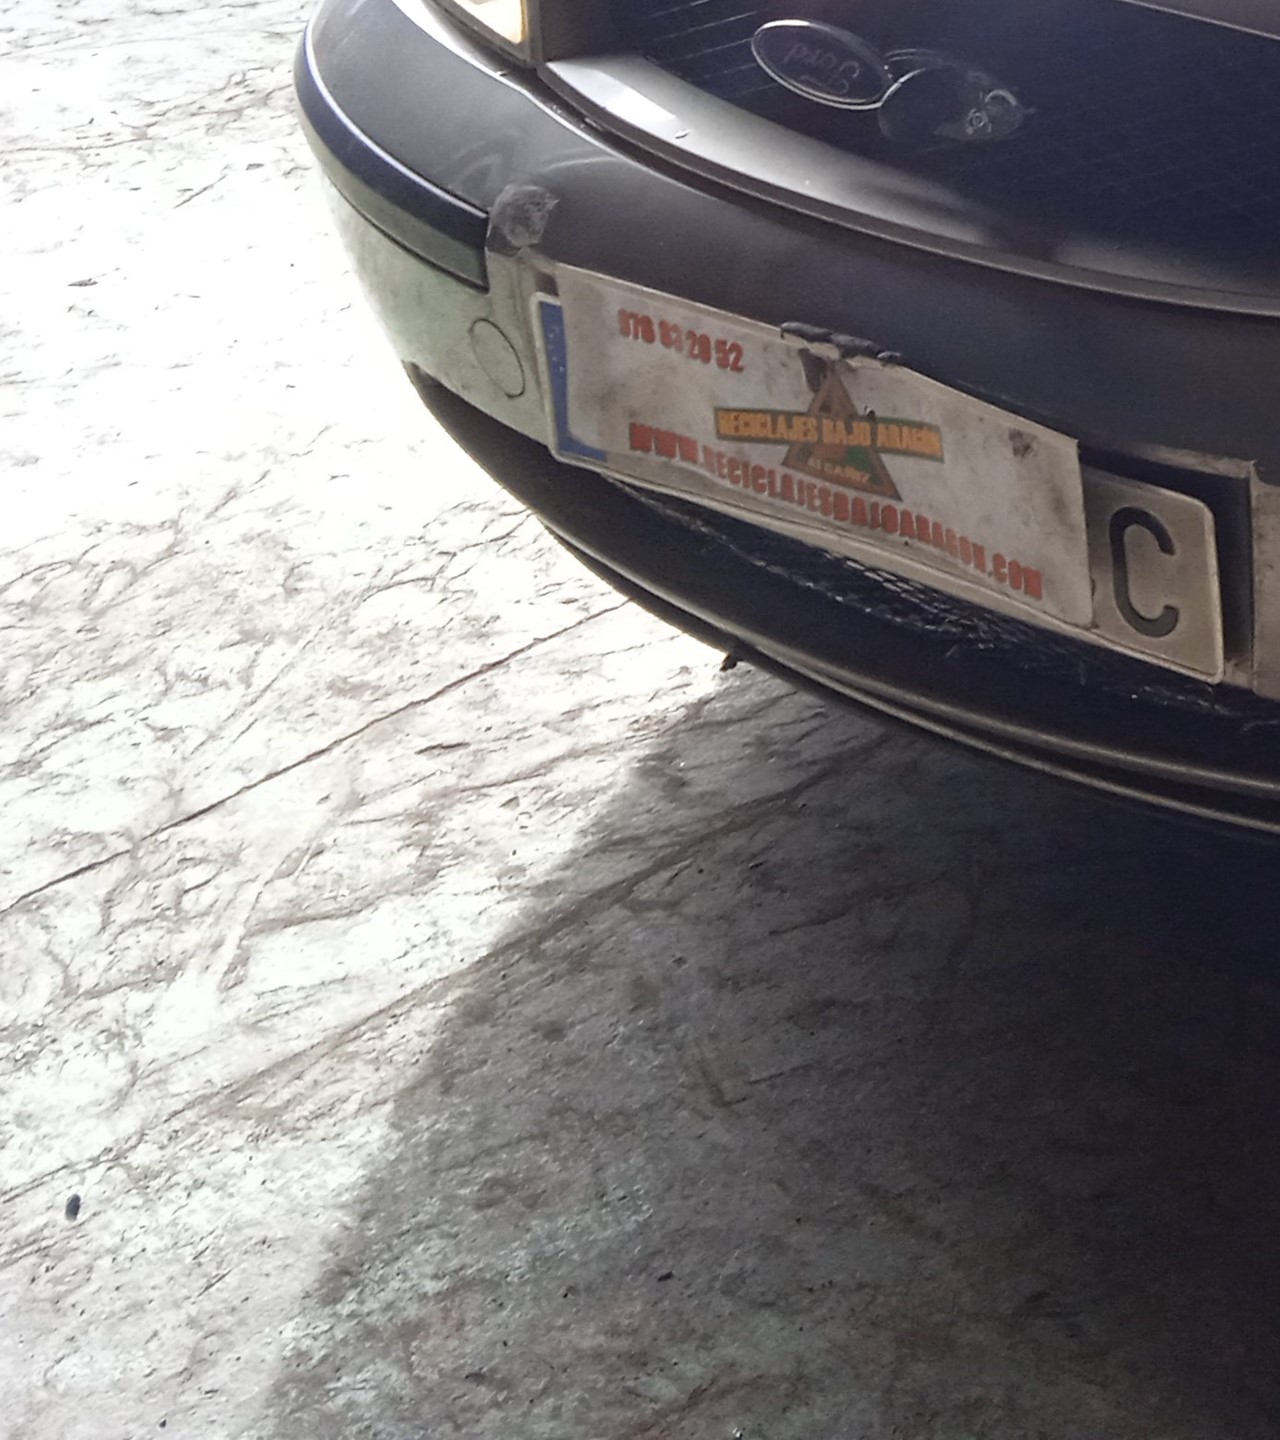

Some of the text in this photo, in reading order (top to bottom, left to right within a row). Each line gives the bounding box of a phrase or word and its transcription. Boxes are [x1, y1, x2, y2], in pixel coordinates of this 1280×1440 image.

[718, 409, 818, 443] RECICLAJES
[822, 417, 872, 447] BAJO
[1108, 506, 1181, 639] C
